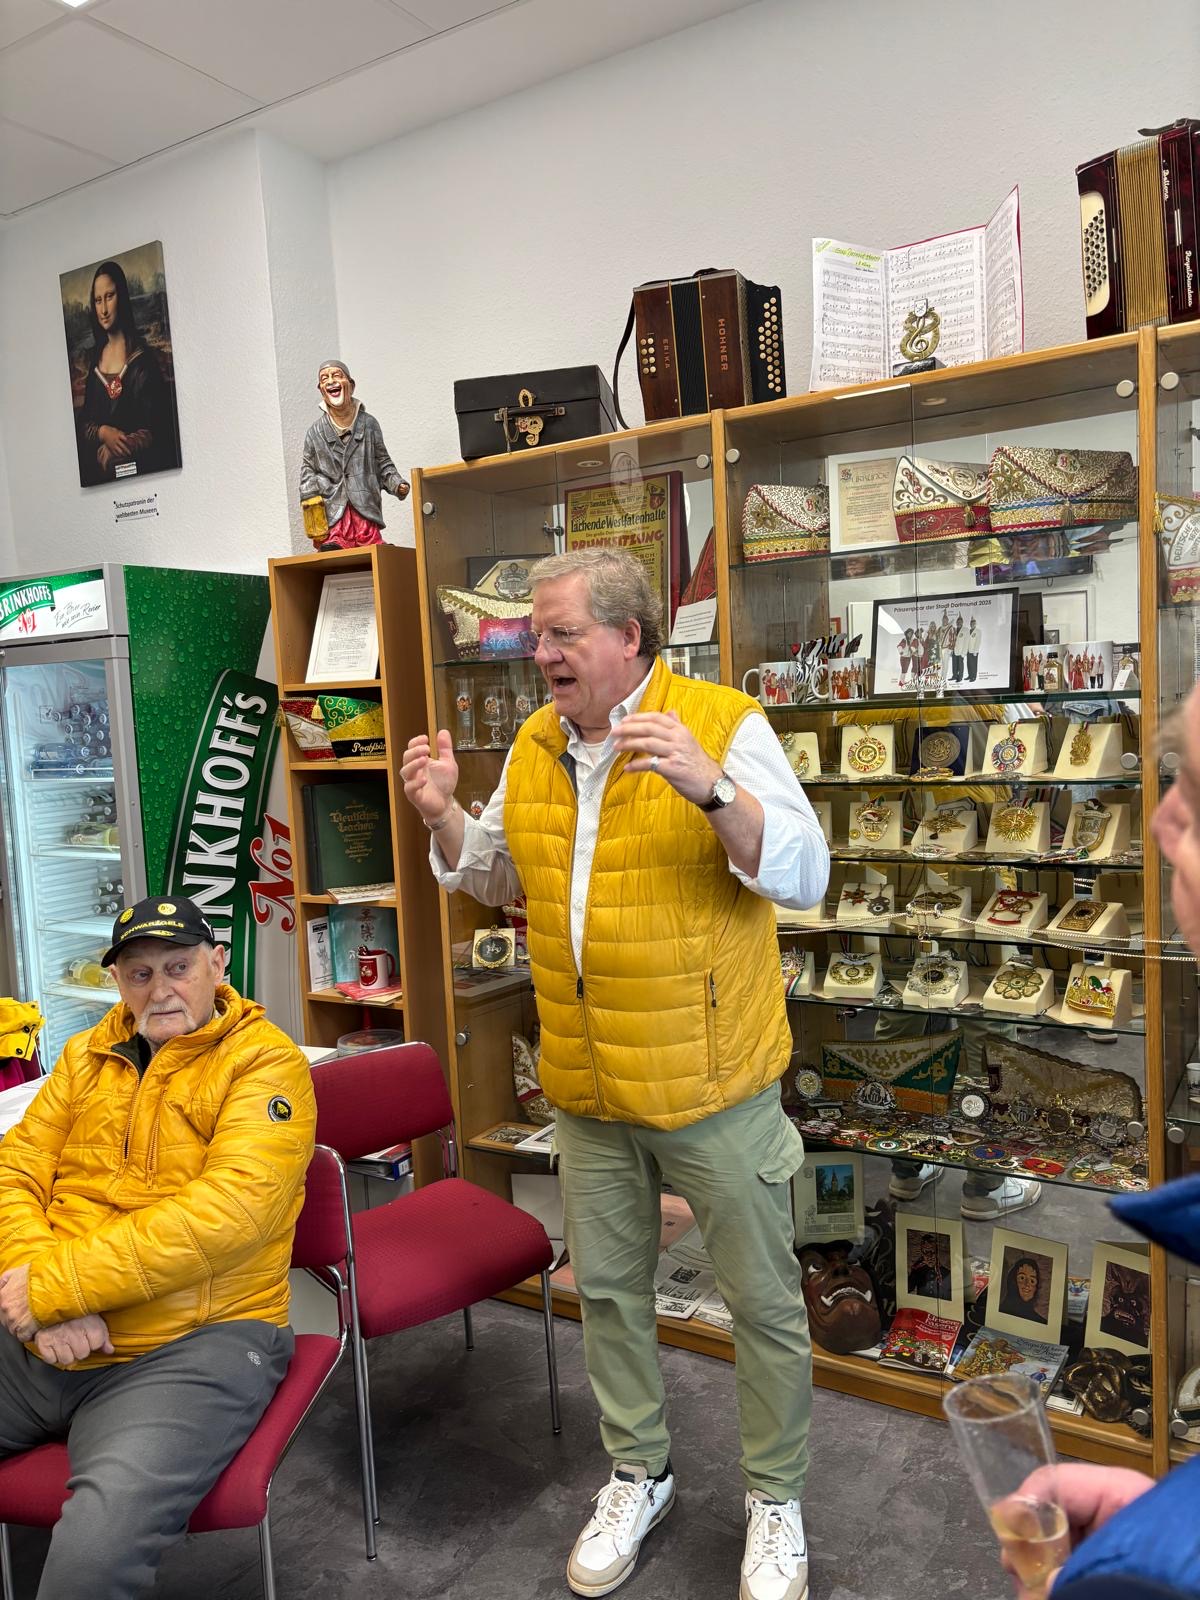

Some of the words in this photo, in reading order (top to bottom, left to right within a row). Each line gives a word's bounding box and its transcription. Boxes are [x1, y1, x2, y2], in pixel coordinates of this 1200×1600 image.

[663, 339, 671, 369] ERIKA
[718, 318, 729, 371] HOHNER
[935, 602, 950, 610] Stadt
[950, 600, 978, 609] Dortmund
[176, 692, 268, 980] NKHOFF's
